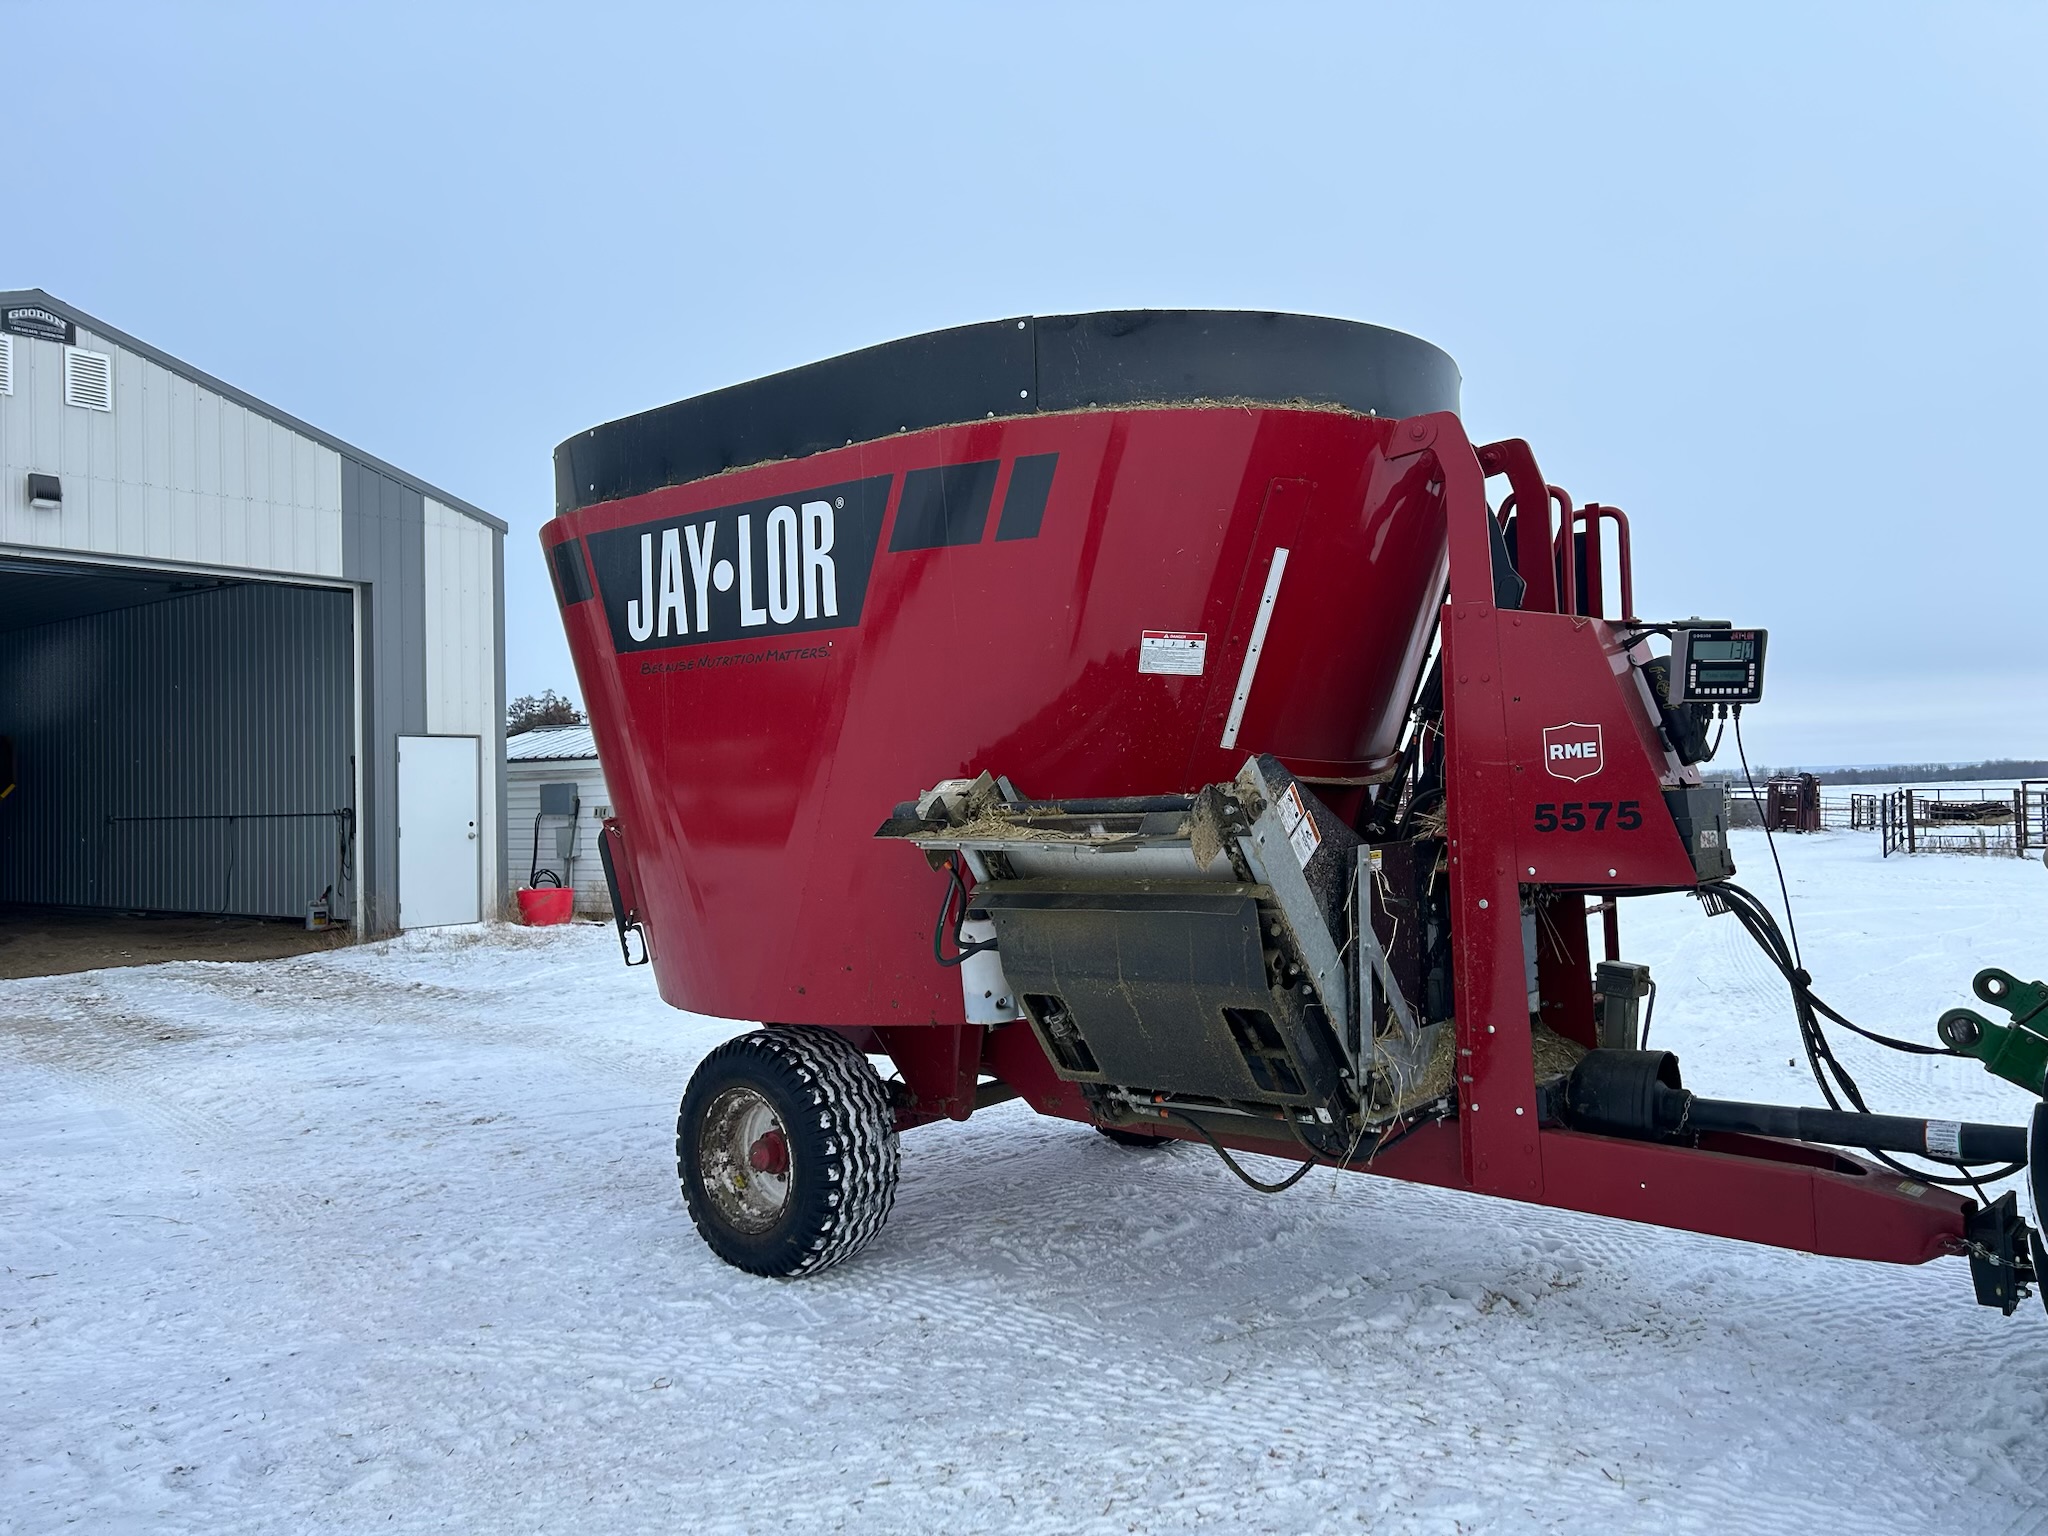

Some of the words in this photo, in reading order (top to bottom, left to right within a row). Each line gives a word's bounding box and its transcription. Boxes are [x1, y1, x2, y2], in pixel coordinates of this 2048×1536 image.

[8, 308, 67, 330] GOODON
[697, 653, 764, 668] NUTRITION
[1550, 742, 1597, 760] RME
[1534, 801, 1642, 832] 5575
